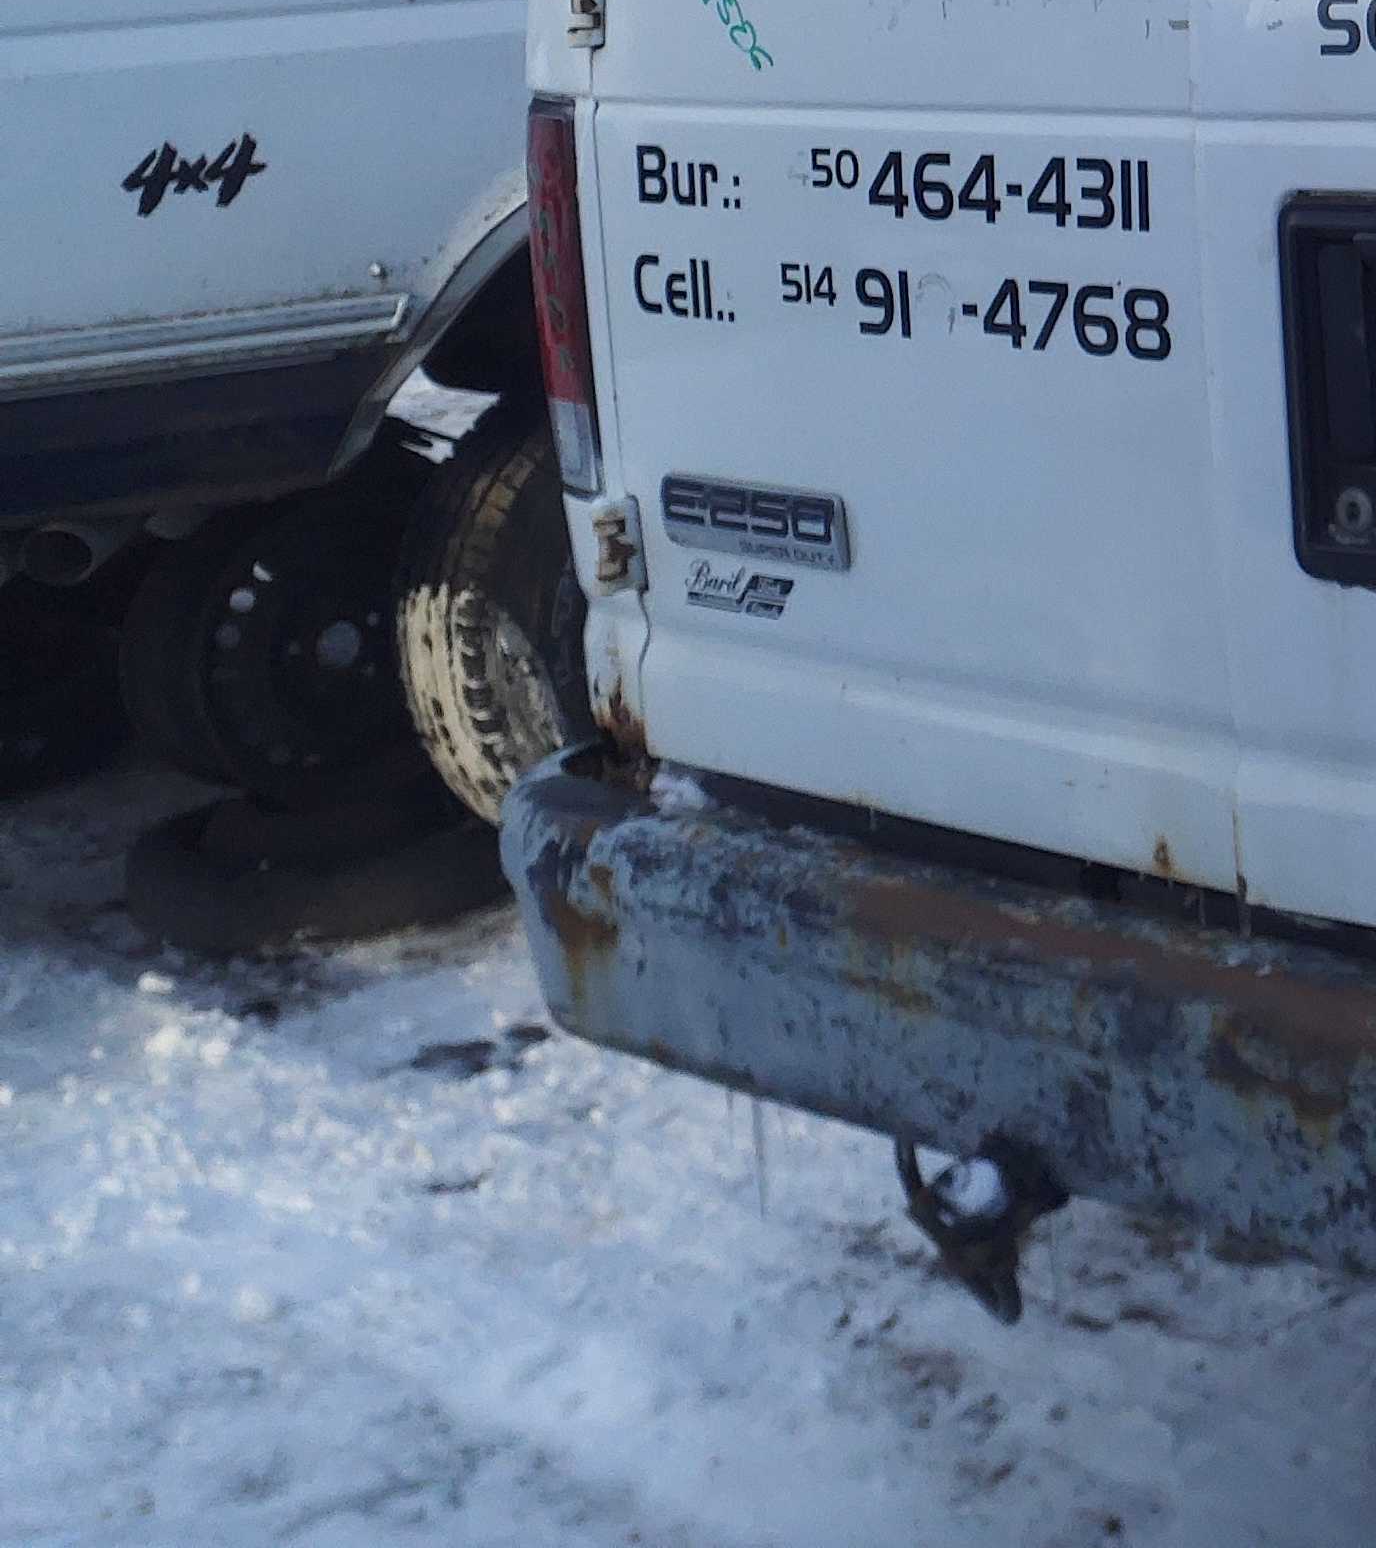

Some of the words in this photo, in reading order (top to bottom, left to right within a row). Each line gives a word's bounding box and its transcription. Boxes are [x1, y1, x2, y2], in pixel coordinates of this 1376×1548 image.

[121, 132, 267, 218] 4x4
[636, 144, 741, 210] Bur.:
[786, 147, 860, 190] 50
[868, 150, 1151, 233] 464-4311
[780, 262, 838, 308] 514
